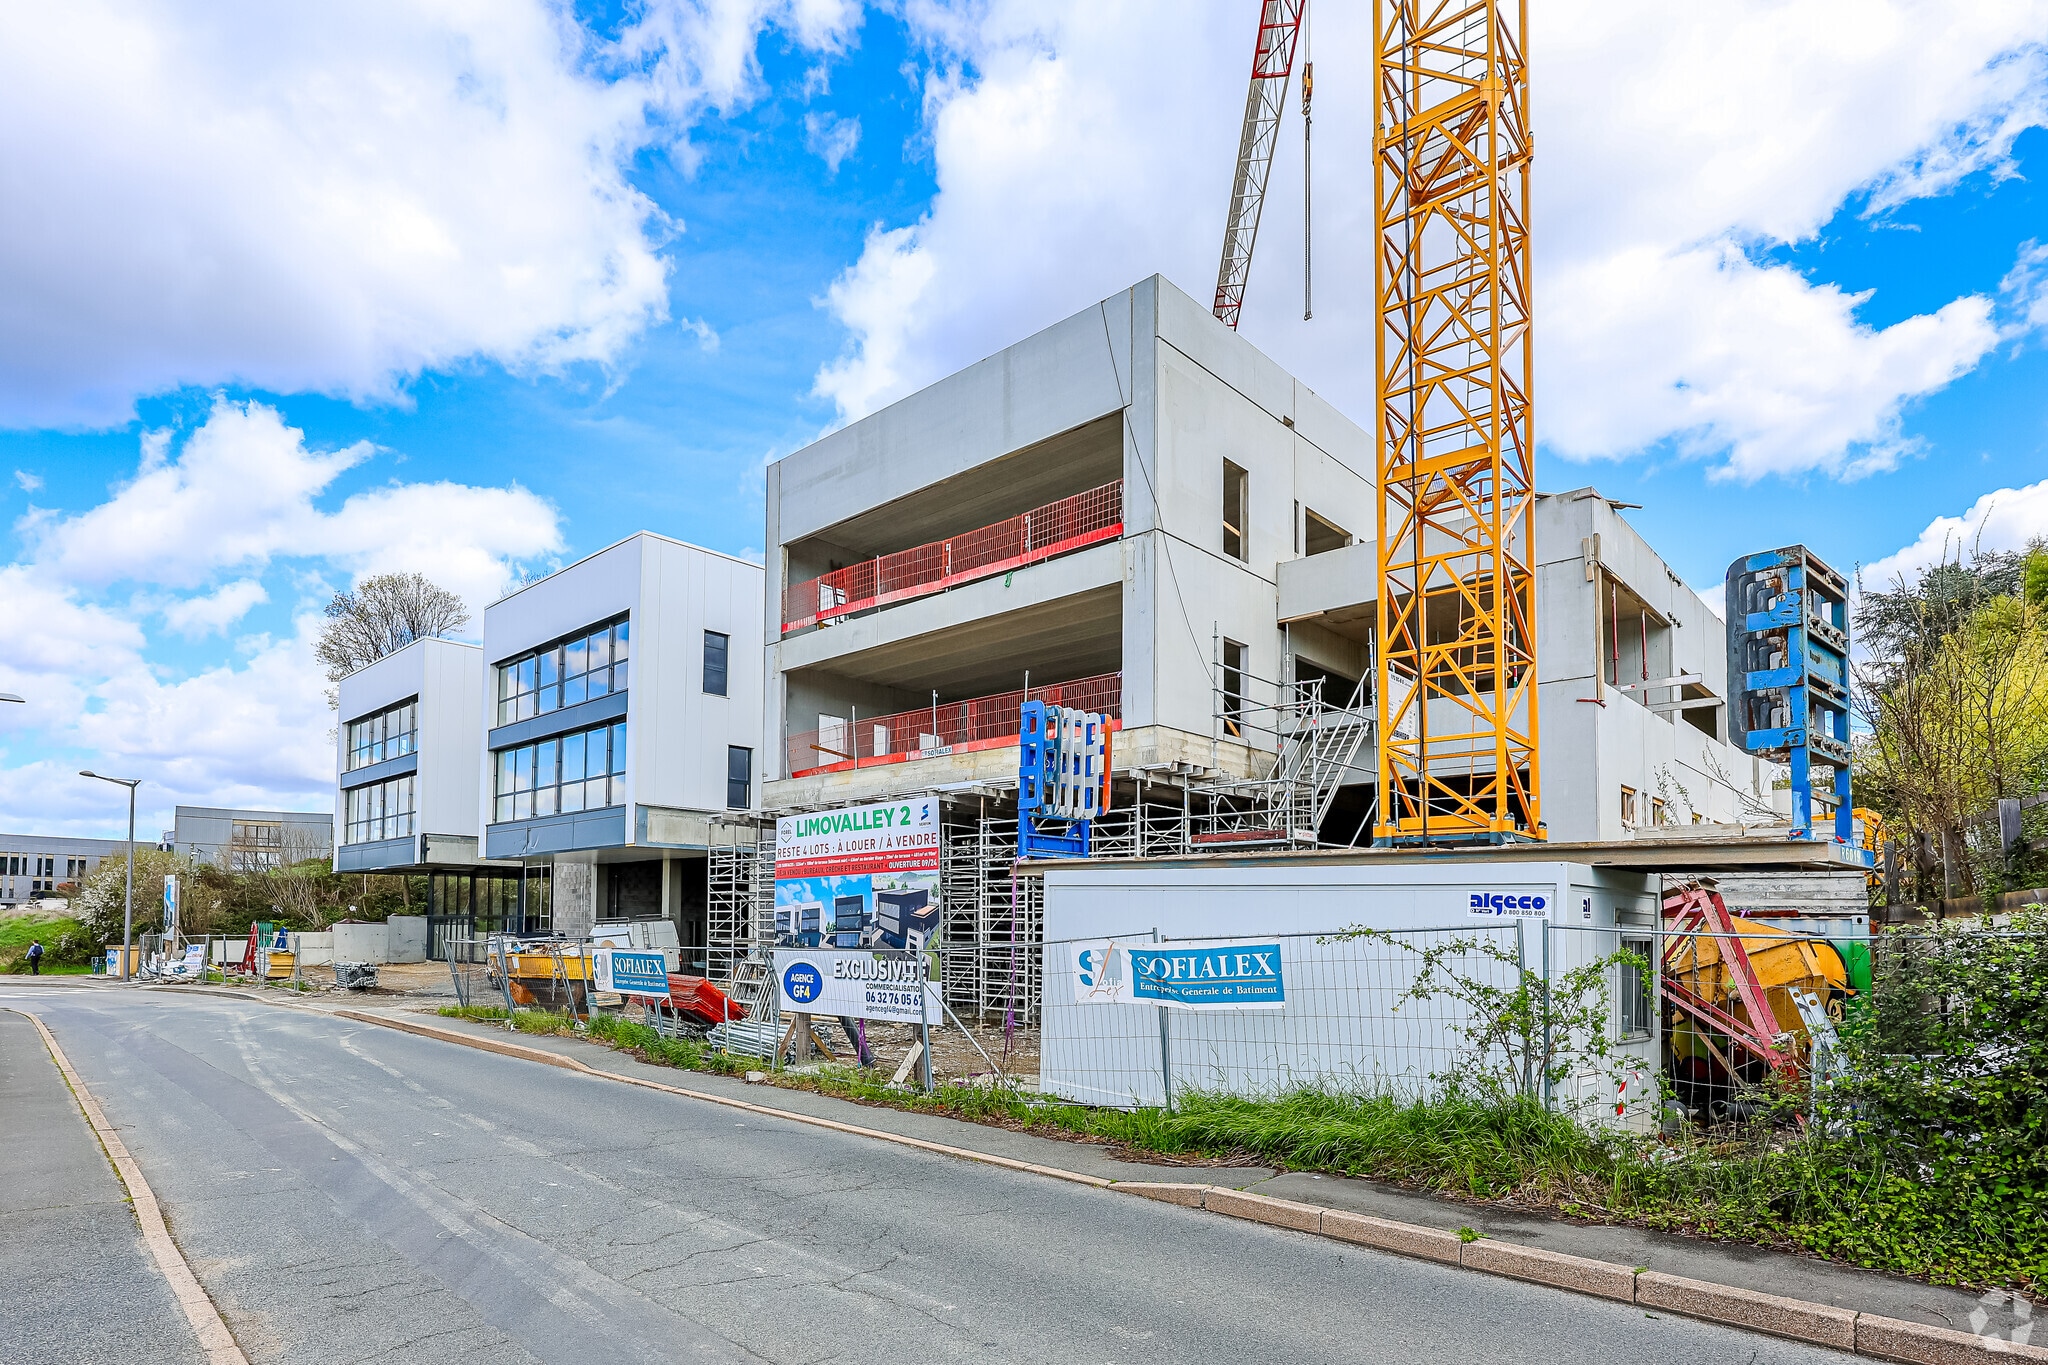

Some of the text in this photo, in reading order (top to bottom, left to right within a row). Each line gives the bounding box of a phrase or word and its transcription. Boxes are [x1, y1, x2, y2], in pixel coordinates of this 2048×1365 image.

[796, 805, 911, 838] LIMOVALLEY 2
[777, 846, 800, 858] RESTE
[803, 845, 807, 855] 4
[810, 843, 829, 855] LOTS
[846, 838, 875, 852] LOUER
[886, 834, 892, 848] À
[897, 832, 937, 846] VENDRE
[852, 863, 884, 871] RESTAURANT
[889, 860, 920, 869] OUVERTURE
[1470, 893, 1546, 916] algeco
[614, 957, 664, 976] SOFIALEX
[1137, 952, 1275, 980] SOFIALEX
[790, 973, 814, 984] AGENCE
[793, 984, 810, 998] GF4
[866, 983, 922, 992] COMMERCIALISATIO
[1182, 986, 1219, 996] Générale
[1222, 986, 1232, 994] de
[1237, 985, 1277, 994] Batiment
[866, 991, 875, 1002] 06
[877, 992, 887, 1003] 32
[889, 992, 899, 1004] 76
[901, 993, 911, 1005] 05
